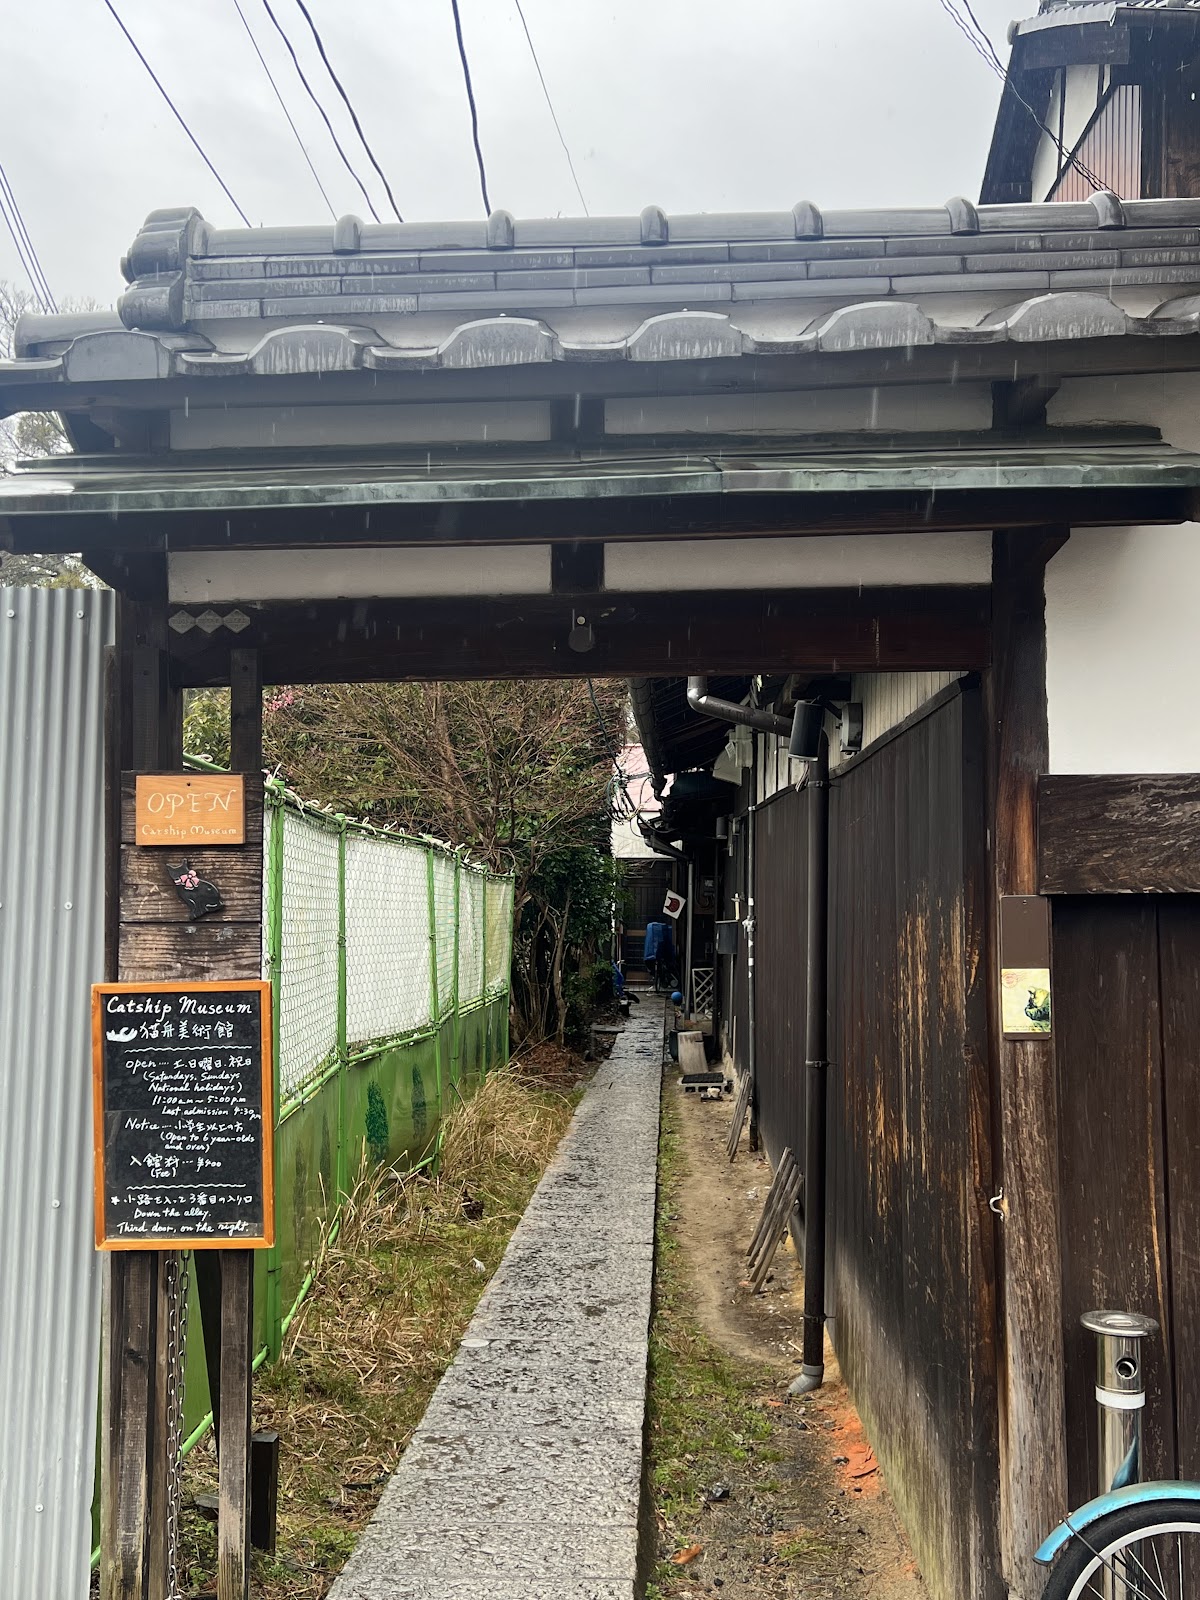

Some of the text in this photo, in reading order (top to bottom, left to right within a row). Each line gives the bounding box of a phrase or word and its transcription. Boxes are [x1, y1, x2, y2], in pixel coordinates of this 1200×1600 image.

[147, 789, 237, 818] OPEN
[190, 825, 238, 835] Museum
[106, 995, 253, 1022] Catship Museum
[139, 1020, 234, 1040] 猫舟美術館
[200, 1071, 241, 1083] Sundays
[148, 1082, 190, 1092] National
[161, 1106, 182, 1116] Last
[184, 1106, 229, 1116] admission
[160, 1131, 255, 1145] (Open to 6 year-olds
[165, 1143, 183, 1151] and
[150, 1167, 177, 1178] (Fee)
[134, 1207, 212, 1221] Down the alley.
[117, 1222, 148, 1234] Third
[196, 1222, 214, 1233] the
